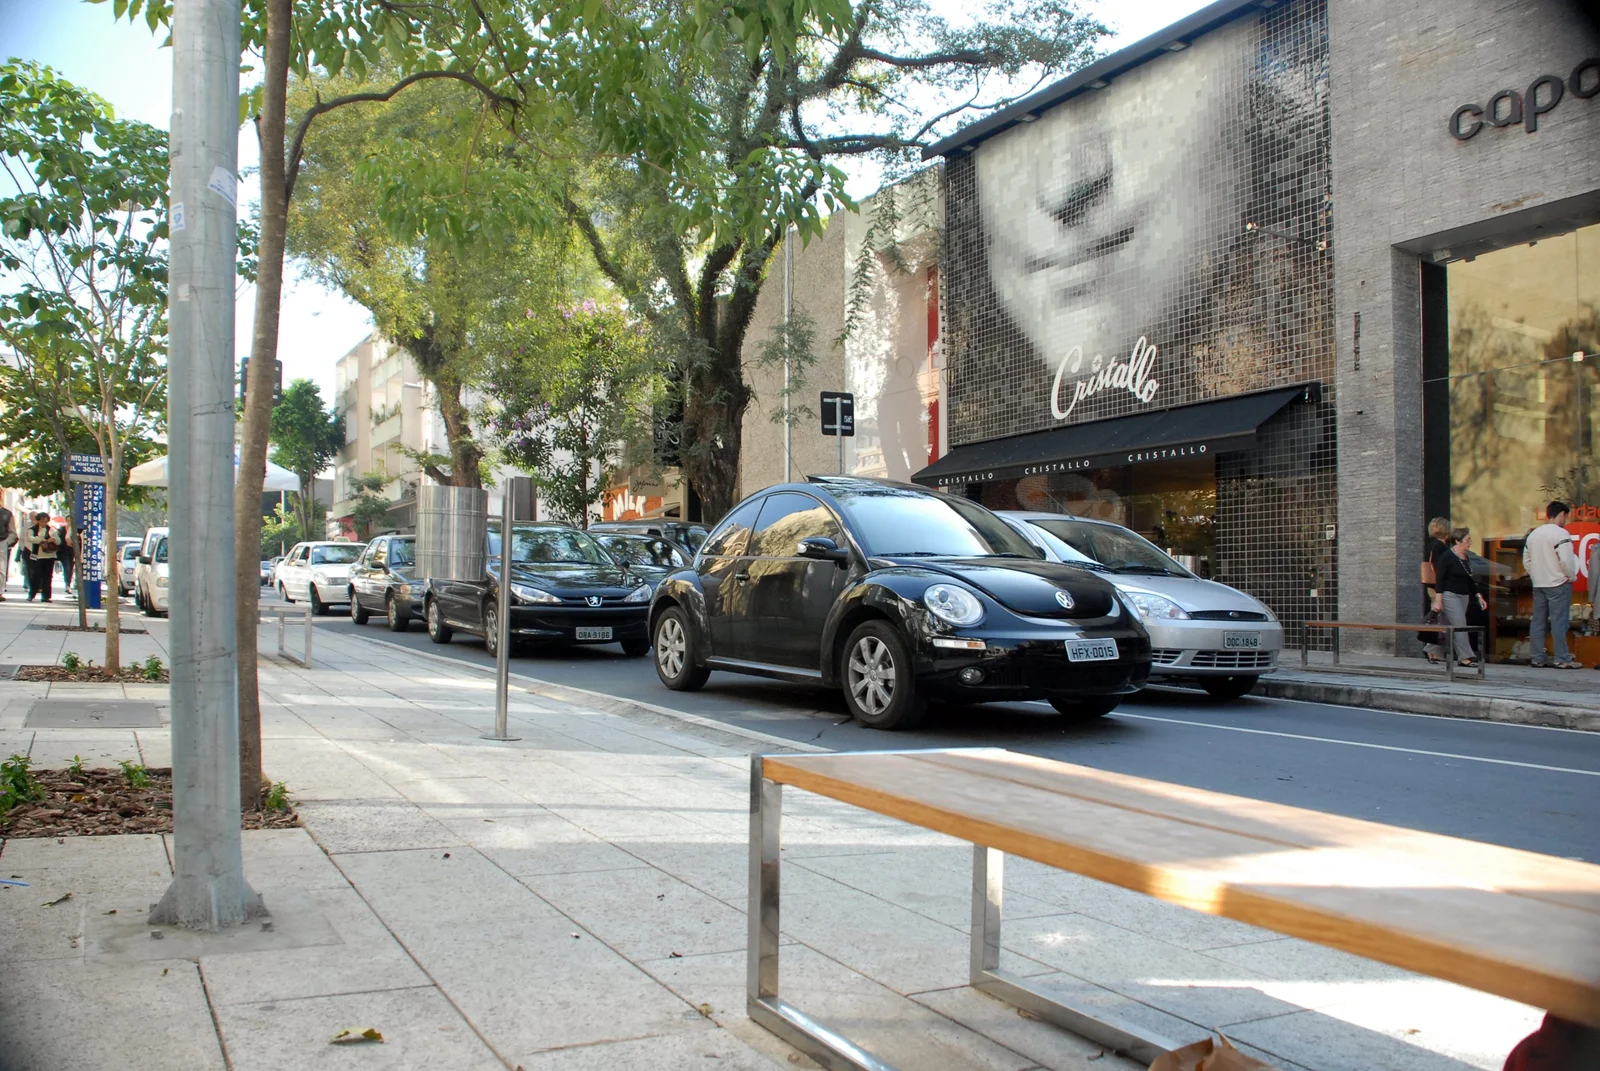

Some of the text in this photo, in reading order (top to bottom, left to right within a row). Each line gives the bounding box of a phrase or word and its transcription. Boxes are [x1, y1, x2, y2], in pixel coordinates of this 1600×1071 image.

[1449, 58, 1600, 141] capo
[1051, 336, 1160, 420] Cristallo
[1128, 445, 1207, 461] CRISTALLO
[938, 472, 994, 486] CRISTALLO
[1024, 460, 1090, 475] CRISTALLO
[613, 488, 646, 521] MILK
